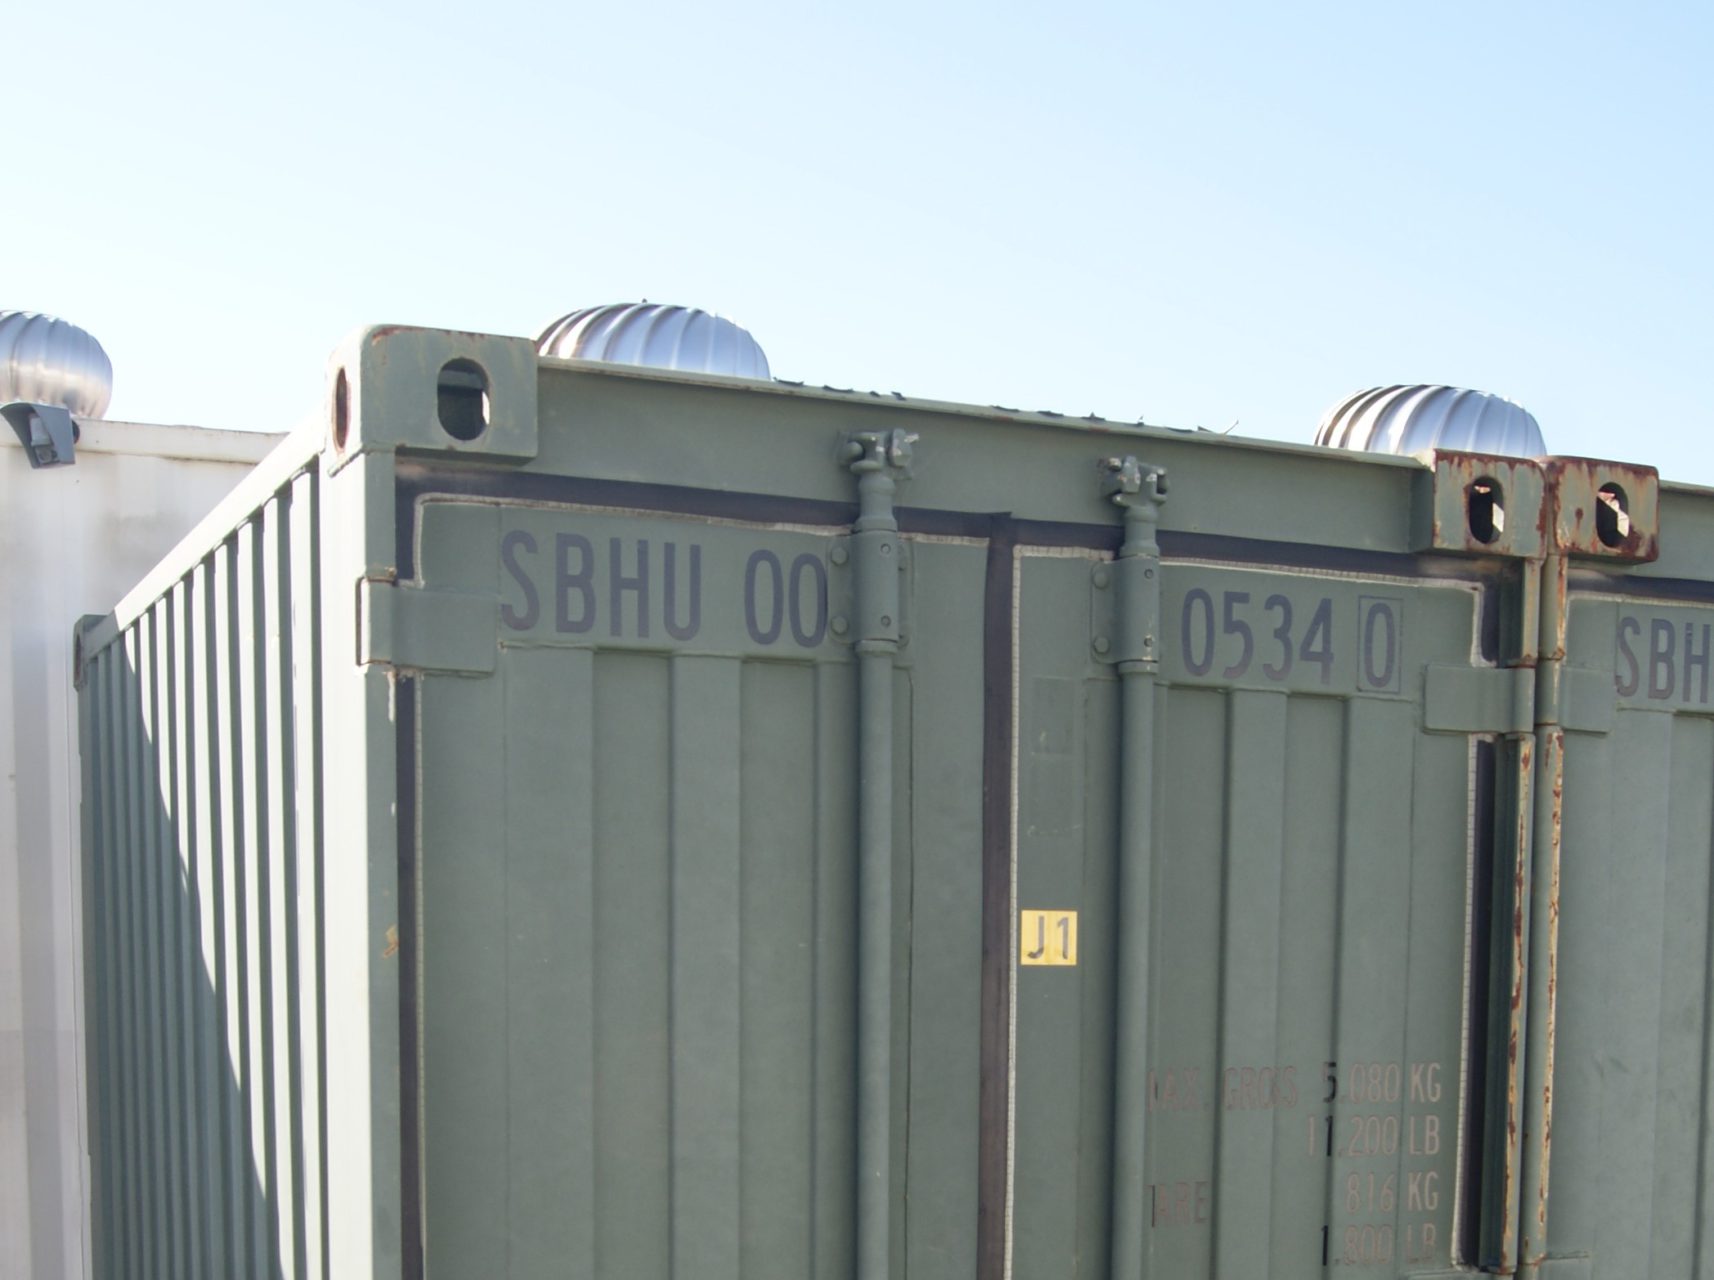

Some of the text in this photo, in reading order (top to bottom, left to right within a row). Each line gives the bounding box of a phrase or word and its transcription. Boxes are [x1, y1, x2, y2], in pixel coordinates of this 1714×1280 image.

[501, 529, 829, 648] SBHU 00
[1181, 587, 1334, 684] 0534
[1616, 616, 1713, 703] SBH
[1027, 915, 1068, 960] J1
[1410, 1062, 1441, 1102] KG
[1409, 1115, 1440, 1155] LB
[1346, 1172, 1395, 1214] 816
[1408, 1171, 1439, 1210] KG
